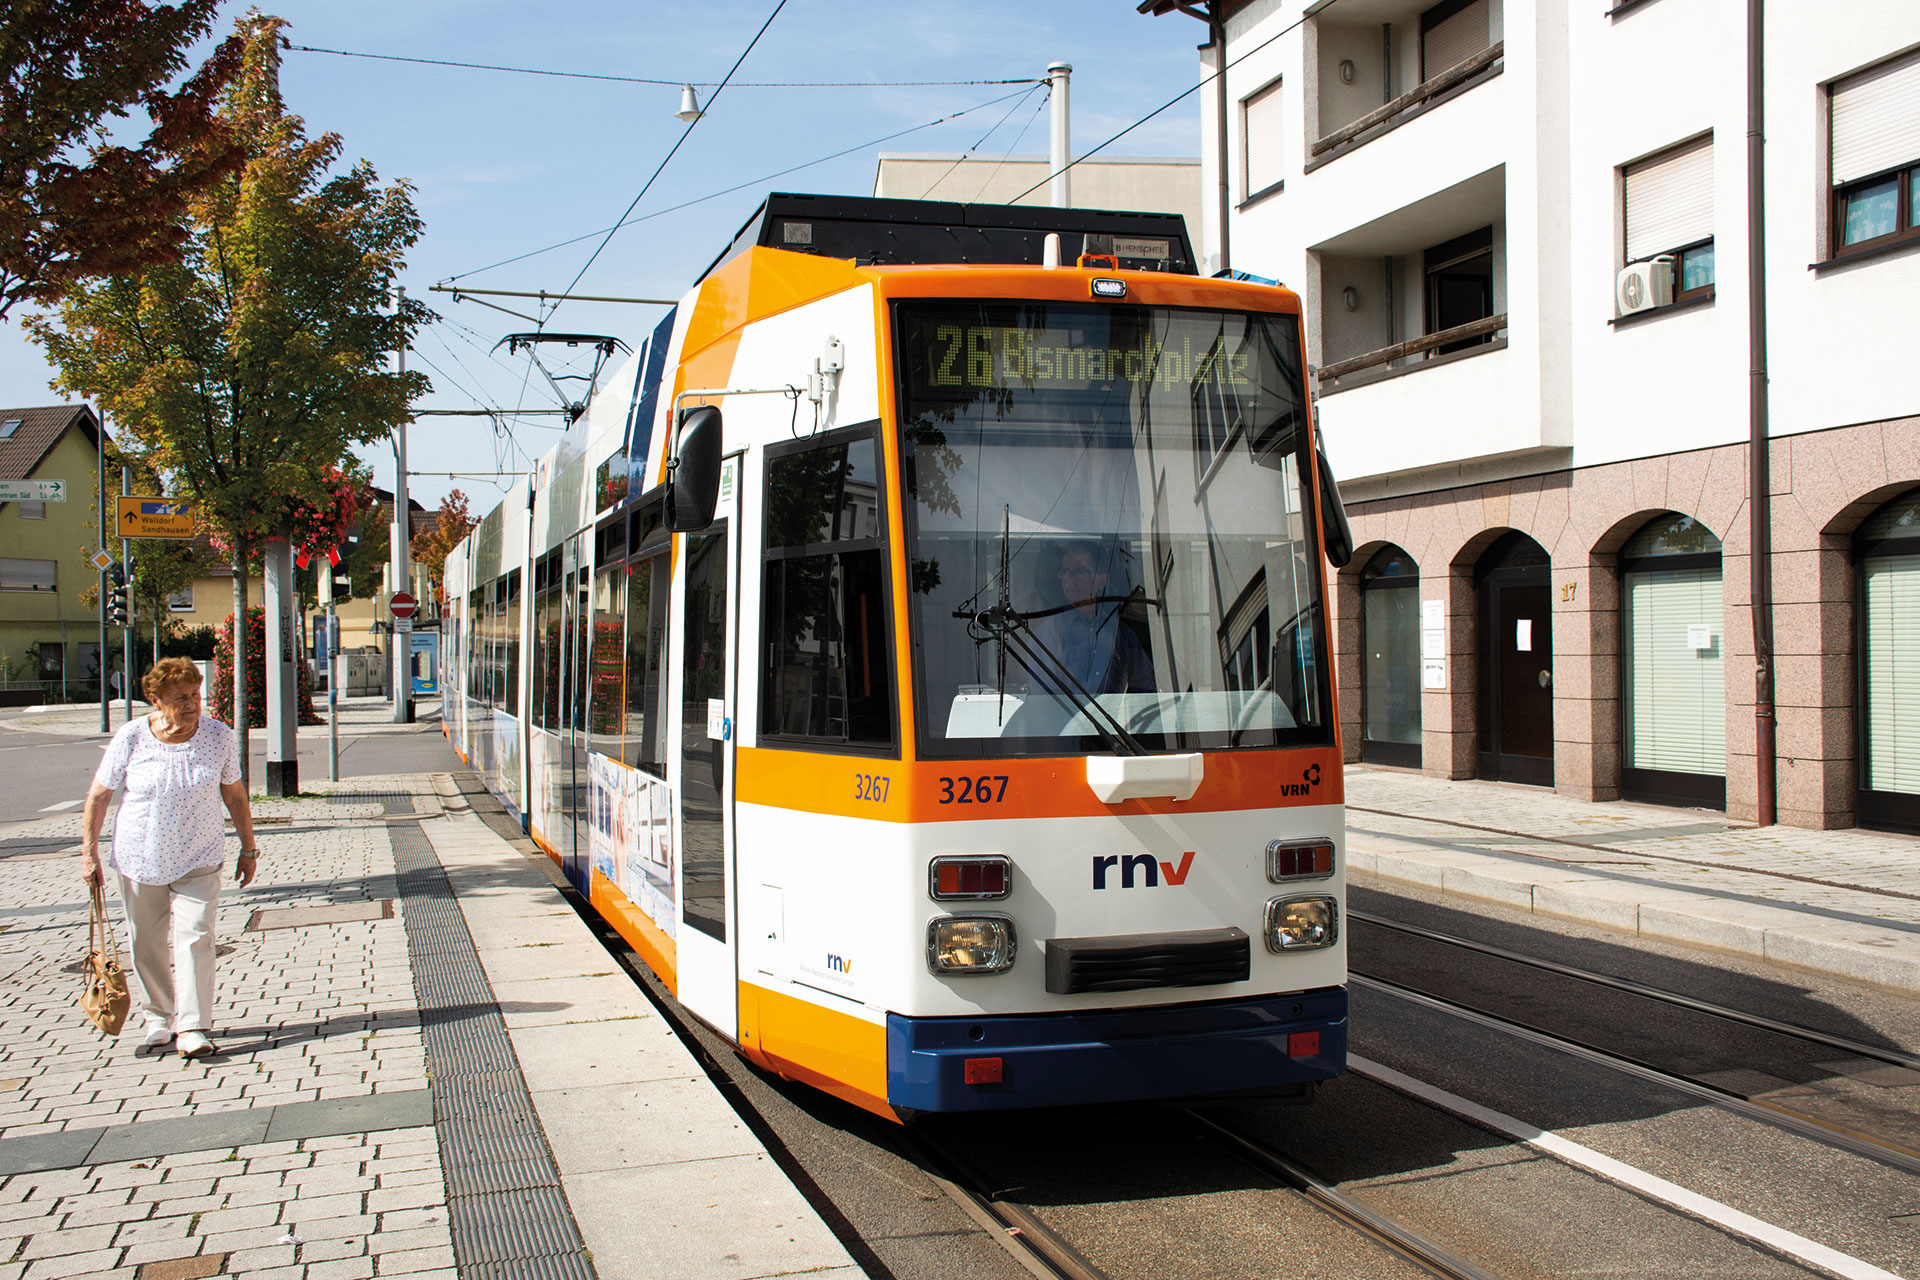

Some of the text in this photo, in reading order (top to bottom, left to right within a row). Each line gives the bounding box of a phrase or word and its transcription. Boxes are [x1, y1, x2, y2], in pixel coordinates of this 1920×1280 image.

[937, 325, 1249, 391] 26 Bismarckplatz
[141, 516, 175, 524] Walldorf
[141, 525, 190, 534] Sandhausen
[1561, 582, 1577, 602] 17
[855, 773, 890, 803] 3267
[938, 776, 1009, 804] 3267
[1280, 783, 1310, 797] VRN
[1093, 851, 1196, 890] rnv
[827, 953, 852, 974] rnv
